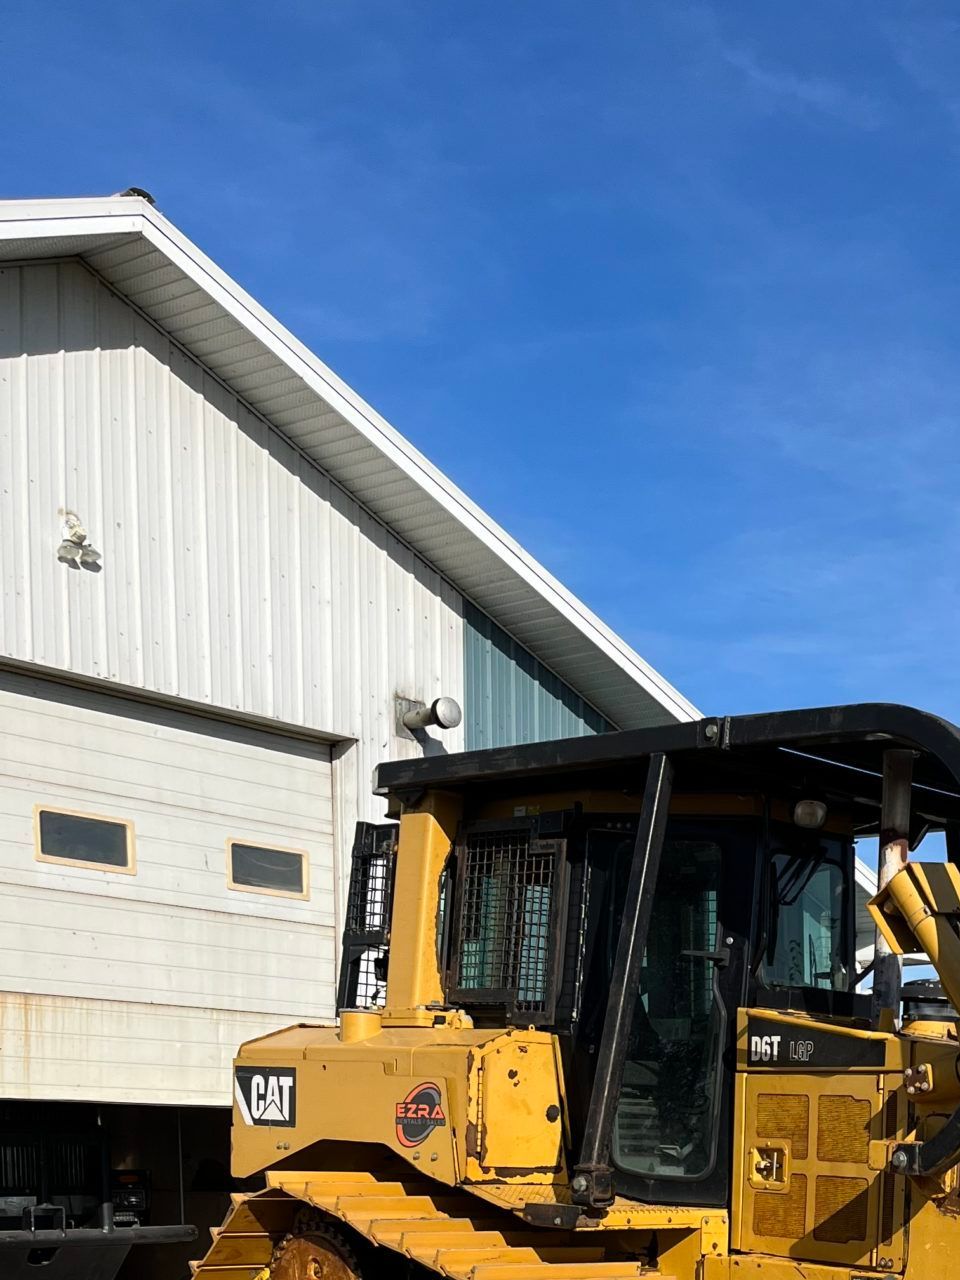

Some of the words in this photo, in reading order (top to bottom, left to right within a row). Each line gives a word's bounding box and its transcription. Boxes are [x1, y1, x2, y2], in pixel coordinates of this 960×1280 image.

[751, 1035, 781, 1062] D6T
[789, 1040, 814, 1062] LGP
[251, 1074, 294, 1121] CAT
[396, 1103, 445, 1119] EZRA
